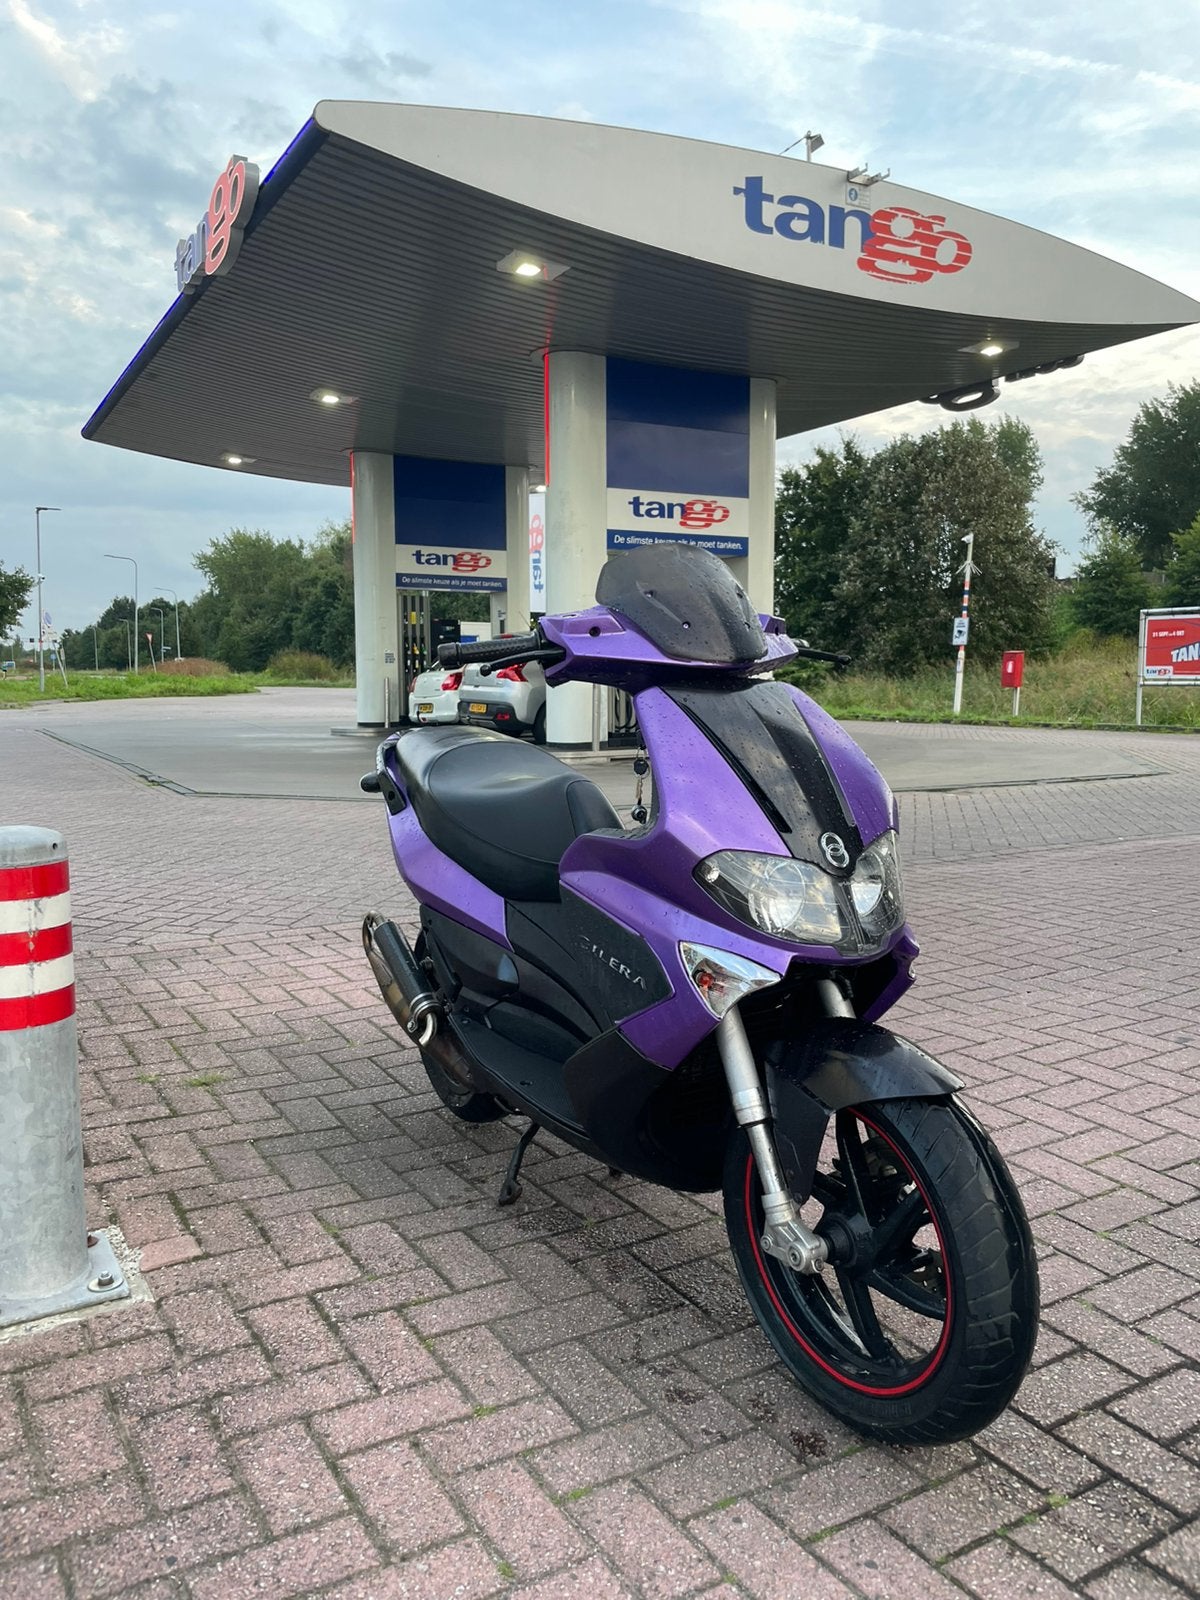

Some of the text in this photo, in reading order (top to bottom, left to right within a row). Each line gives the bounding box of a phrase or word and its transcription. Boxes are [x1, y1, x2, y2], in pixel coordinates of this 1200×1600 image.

[174, 155, 247, 292] tango
[733, 176, 973, 285] tango
[628, 496, 730, 530] tango
[613, 534, 625, 544] De
[626, 536, 653, 545] slimste
[697, 540, 716, 549] moet
[716, 541, 743, 550] tanken.
[412, 549, 492, 573] tango
[402, 576, 411, 584] De
